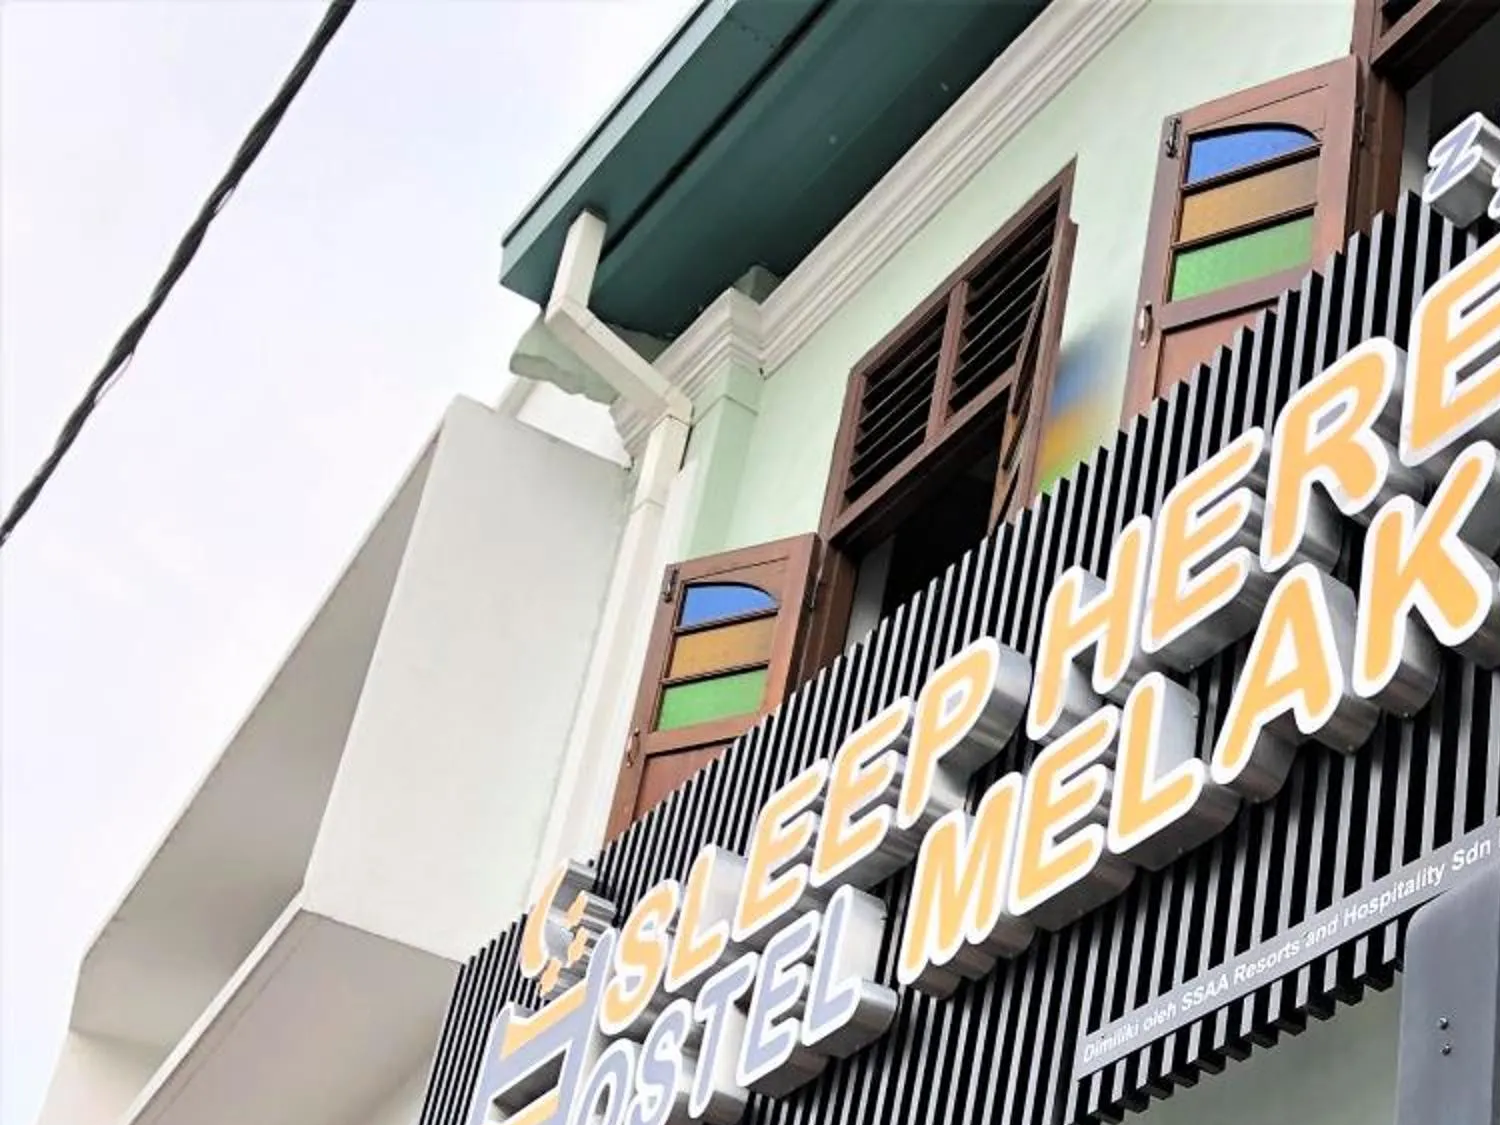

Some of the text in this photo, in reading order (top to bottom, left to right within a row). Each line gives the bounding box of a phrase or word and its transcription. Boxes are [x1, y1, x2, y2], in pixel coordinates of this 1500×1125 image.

[598, 635, 999, 1035] SLEEP
[1083, 1022, 1140, 1063] Dimiliki
[1143, 1003, 1178, 1032] oleh
[1181, 973, 1229, 1012] SSAA
[1233, 937, 1301, 984] Resorts
[1305, 915, 1340, 949] and
[1343, 862, 1446, 927] Hospitality
[1452, 838, 1491, 872] Sdn
